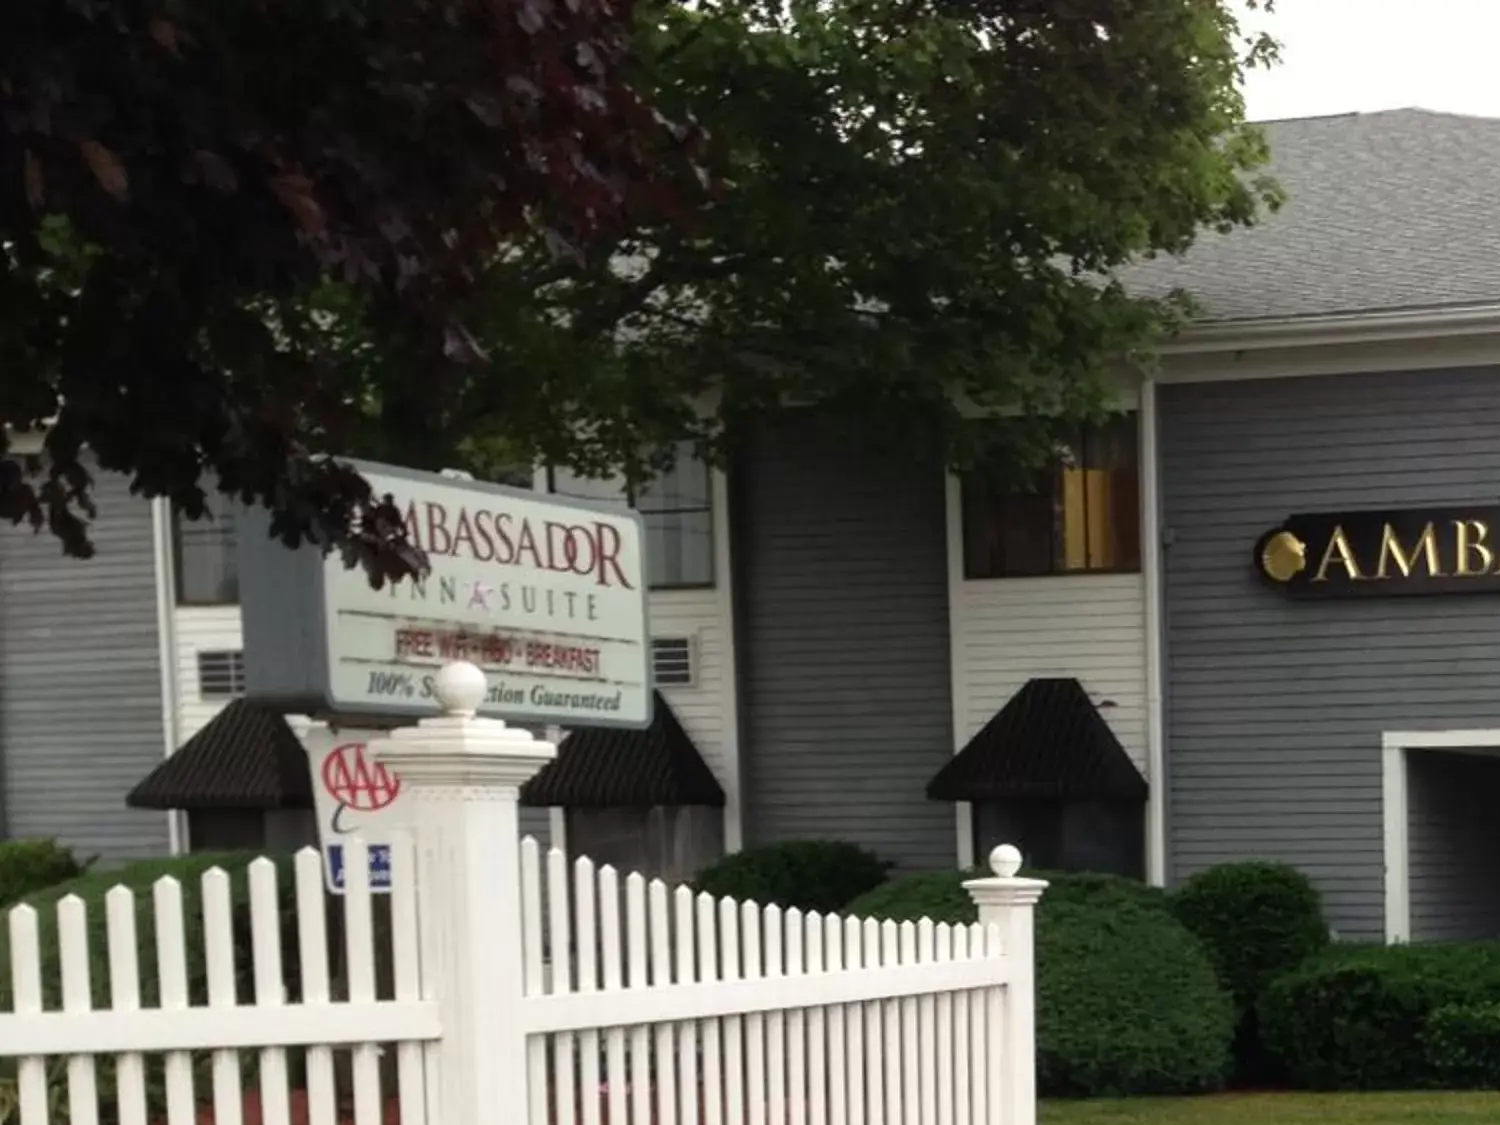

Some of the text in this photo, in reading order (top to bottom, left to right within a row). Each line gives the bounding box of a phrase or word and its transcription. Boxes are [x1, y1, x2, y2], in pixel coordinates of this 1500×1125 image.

[500, 582, 599, 621] SUITE
[367, 671, 415, 698] 100%
[530, 684, 622, 711] Guaranteed
[332, 744, 397, 808] AAA
